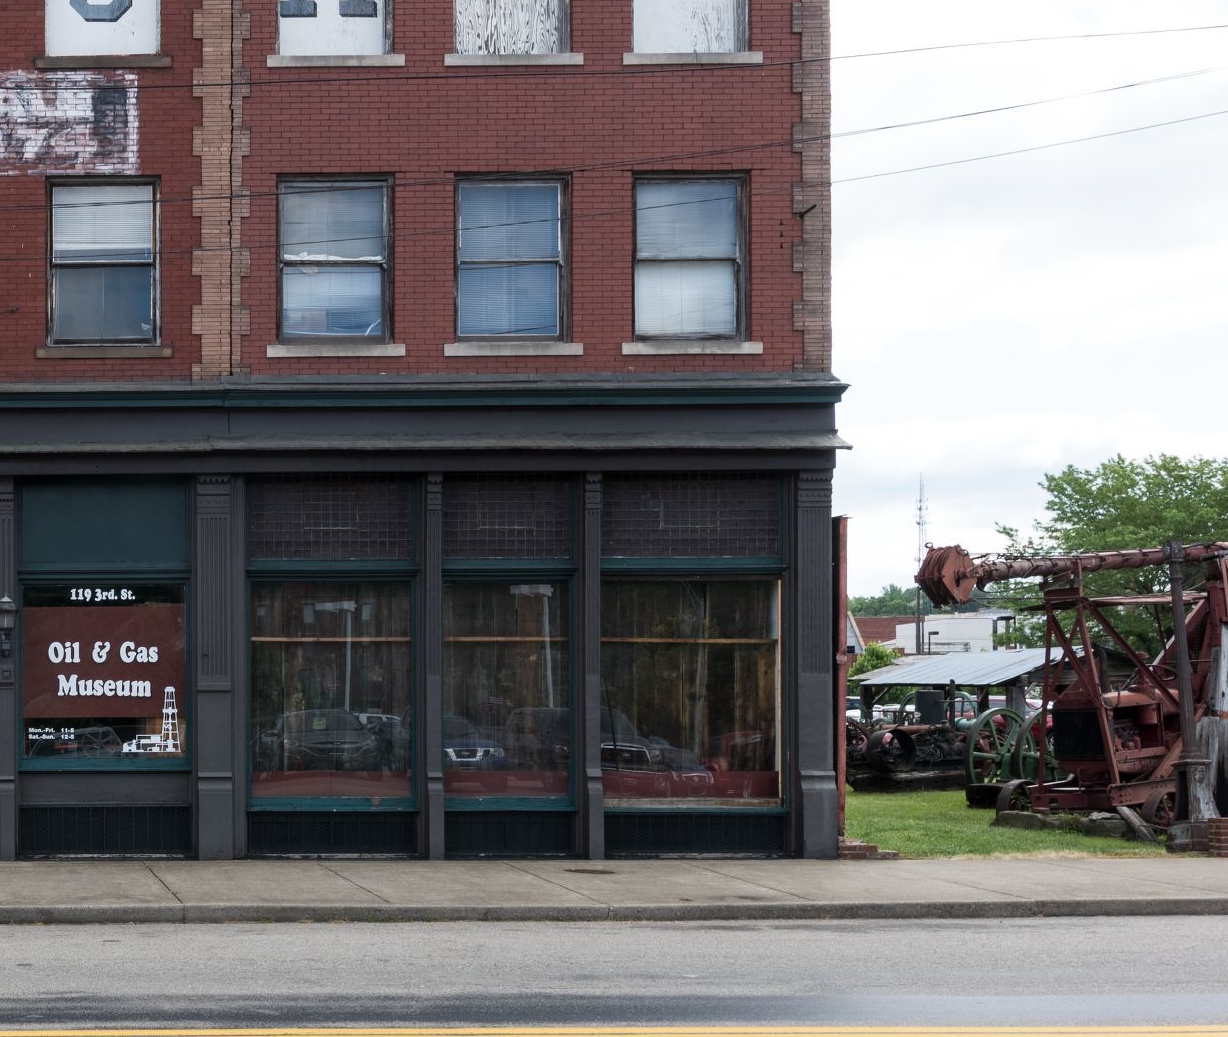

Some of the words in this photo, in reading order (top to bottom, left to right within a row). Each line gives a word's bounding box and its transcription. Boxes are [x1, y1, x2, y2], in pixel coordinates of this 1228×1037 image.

[70, 588, 92, 602] 119
[94, 588, 118, 602] 3rd.
[120, 588, 136, 601] St.
[47, 641, 81, 664] Oil
[92, 641, 111, 664] &
[119, 640, 159, 664] Gas
[57, 674, 152, 698] Museum
